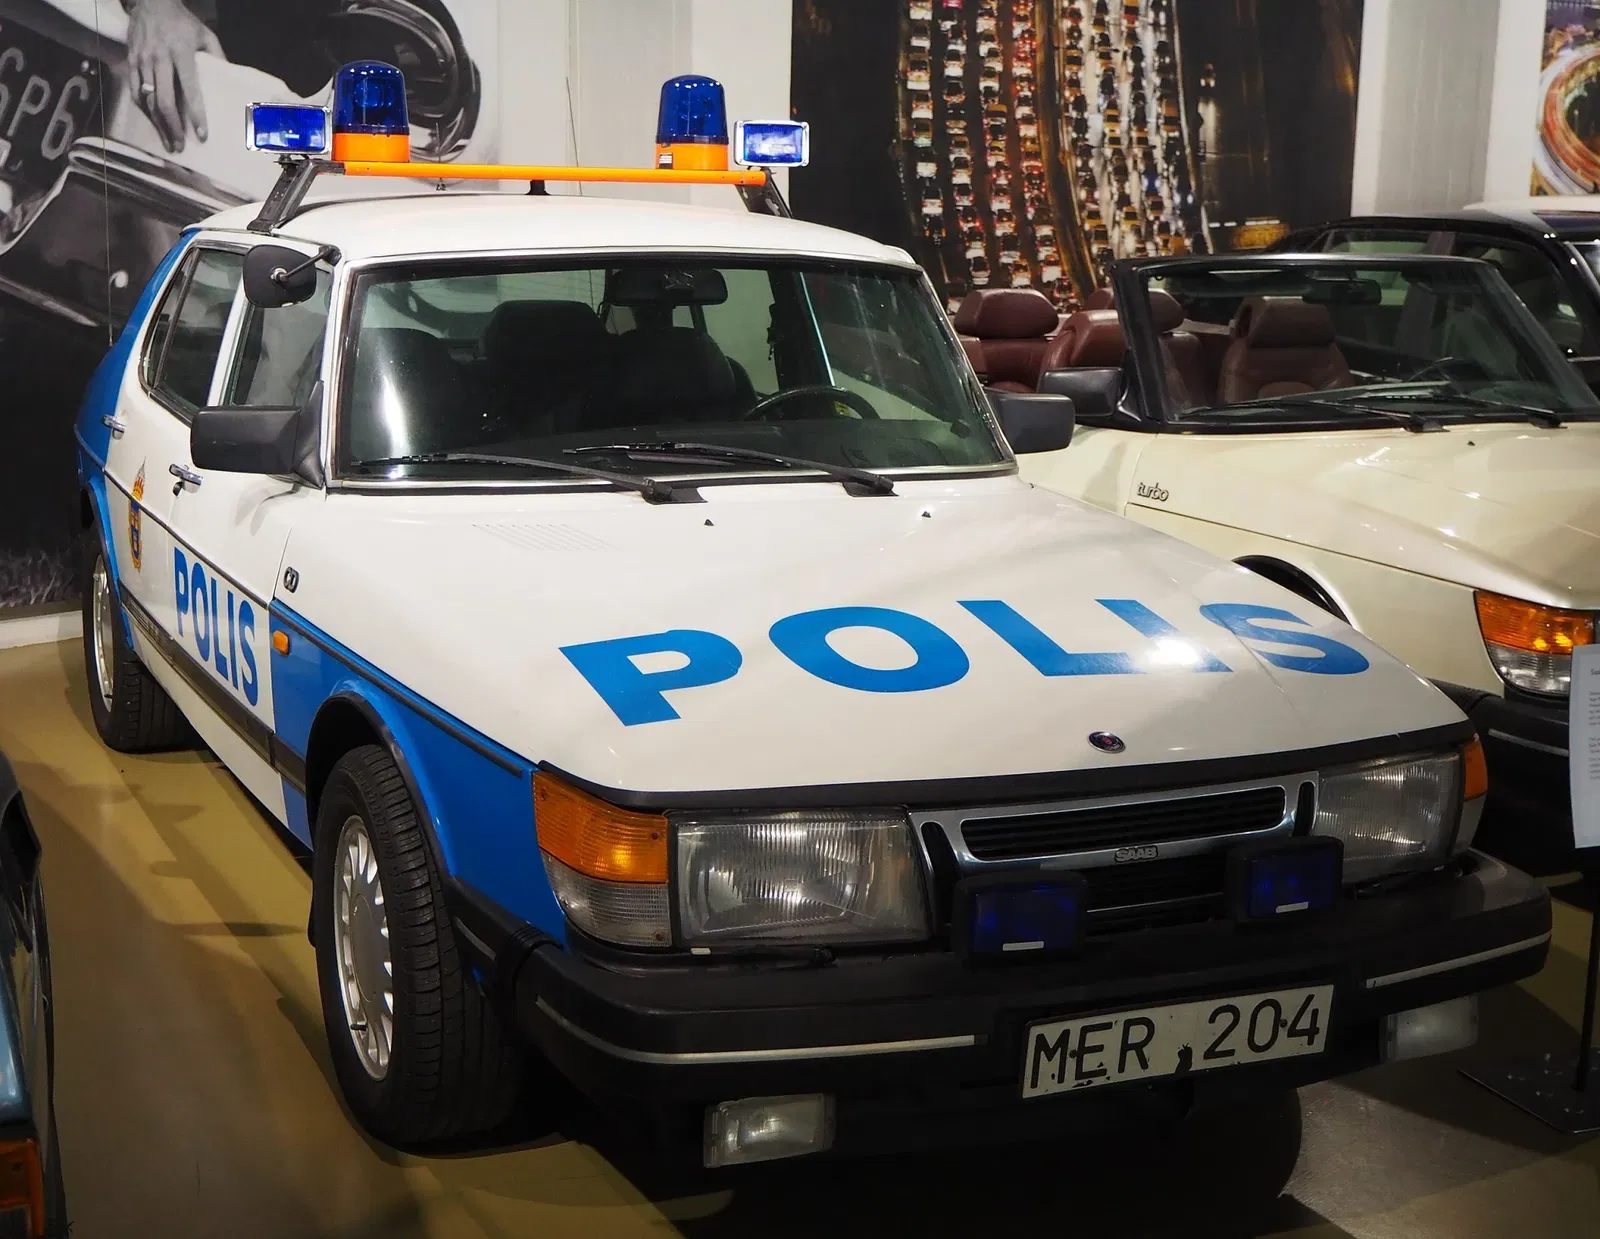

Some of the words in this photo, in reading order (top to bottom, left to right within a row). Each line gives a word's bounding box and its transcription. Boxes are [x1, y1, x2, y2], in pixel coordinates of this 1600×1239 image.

[1137, 481, 1169, 502] turbo
[174, 547, 259, 706] POLIS
[558, 599, 1370, 726] POLIS
[1114, 845, 1158, 863] SAAB
[1030, 1016, 1156, 1089] MER
[1203, 994, 1320, 1060] 204
